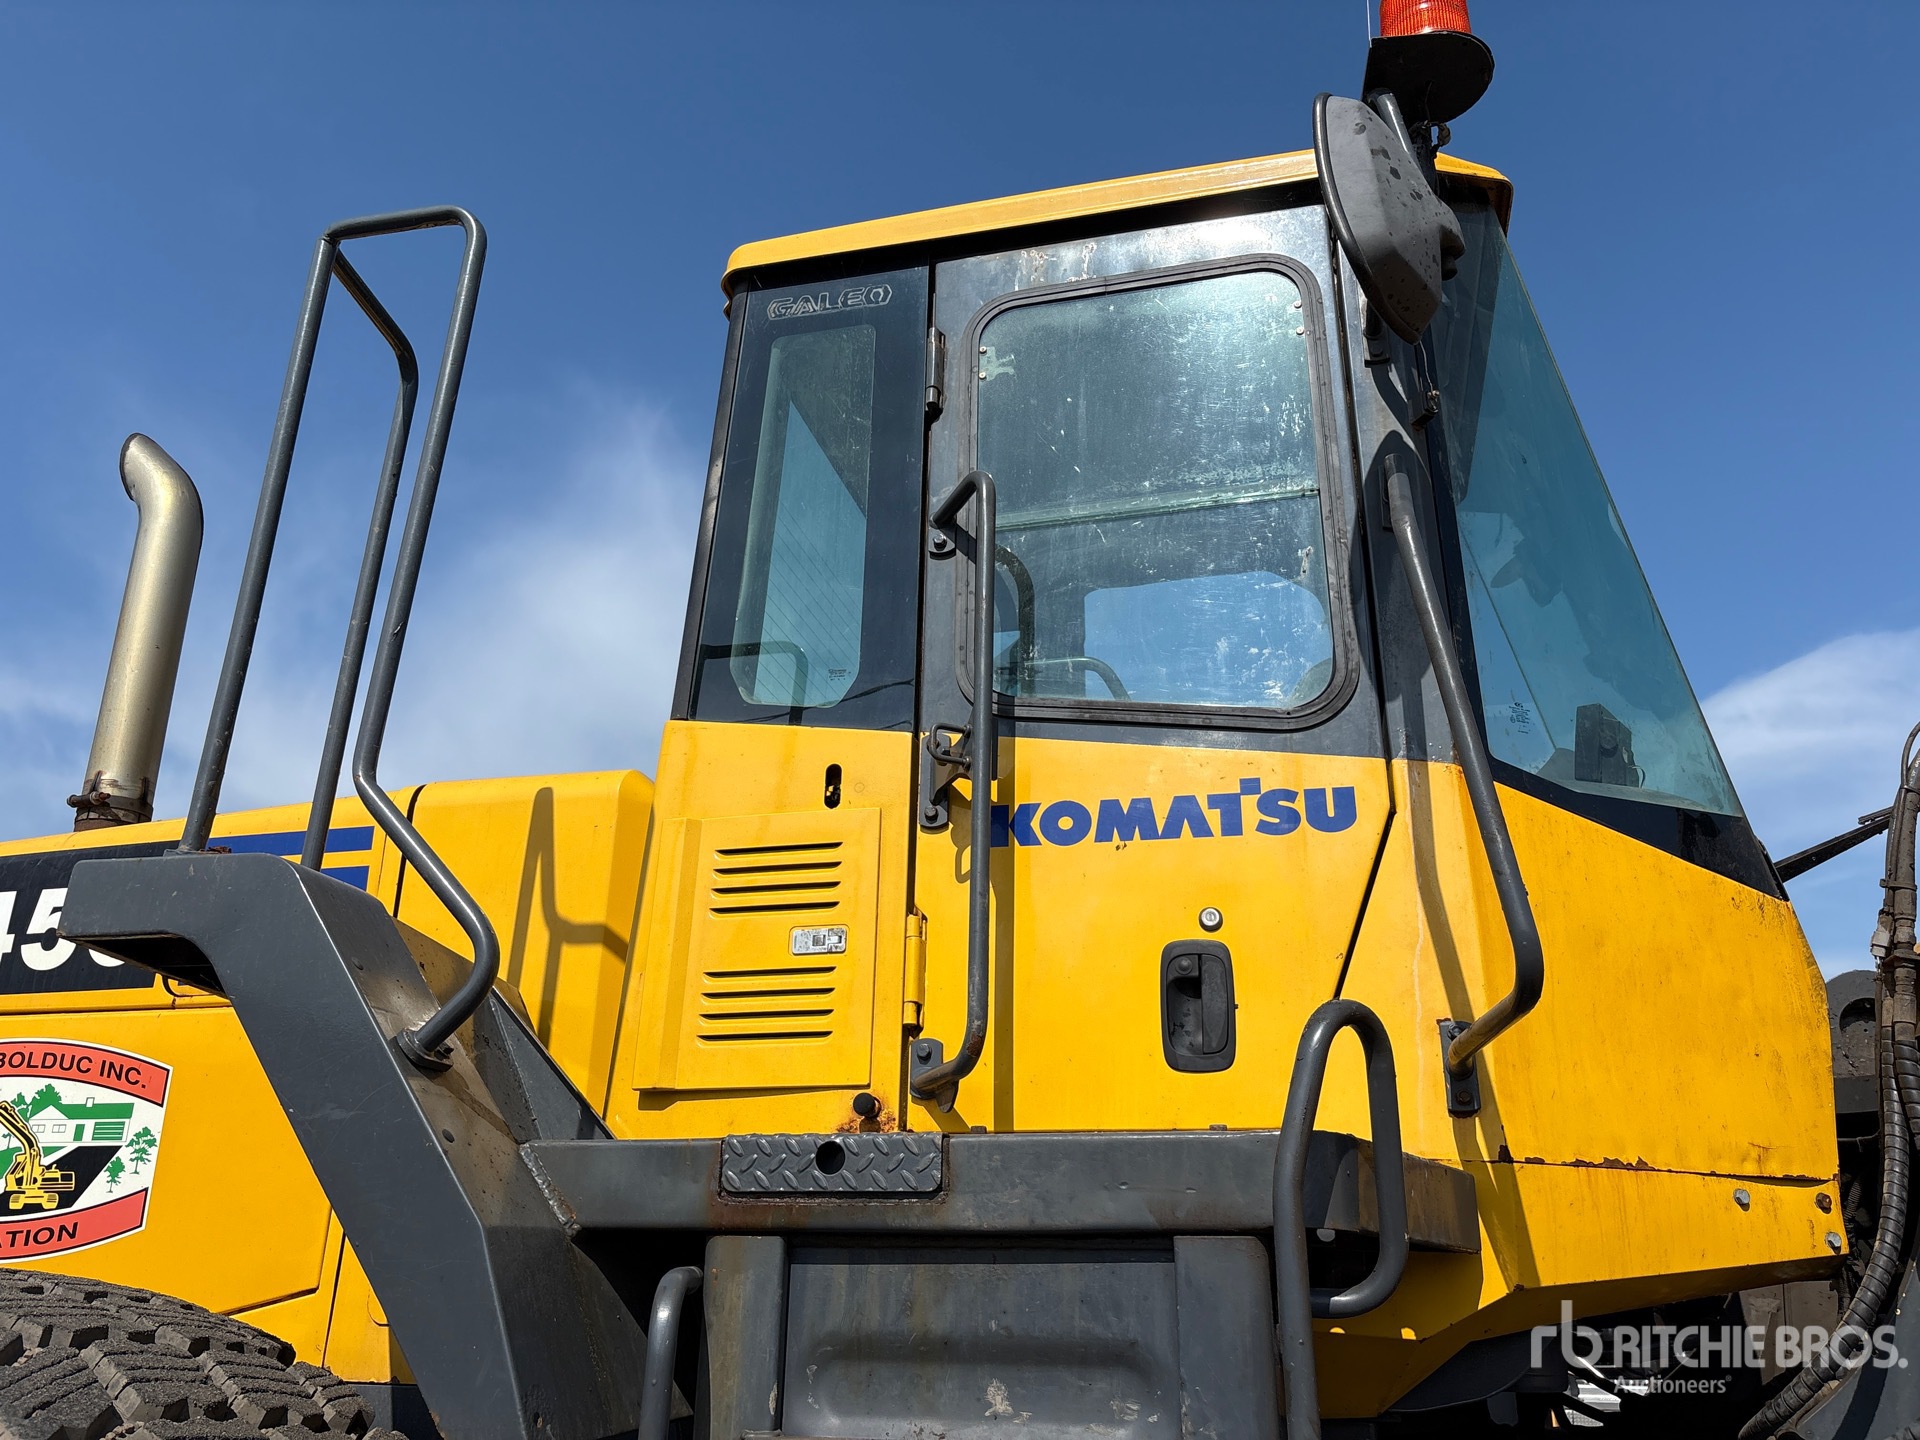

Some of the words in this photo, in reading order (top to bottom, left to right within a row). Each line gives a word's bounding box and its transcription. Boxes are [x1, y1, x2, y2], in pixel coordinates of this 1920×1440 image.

[767, 284, 893, 320] GALEO
[991, 777, 1358, 847] KOMATSU
[99, 1059, 147, 1089] INC.
[0, 1221, 79, 1249] TION
